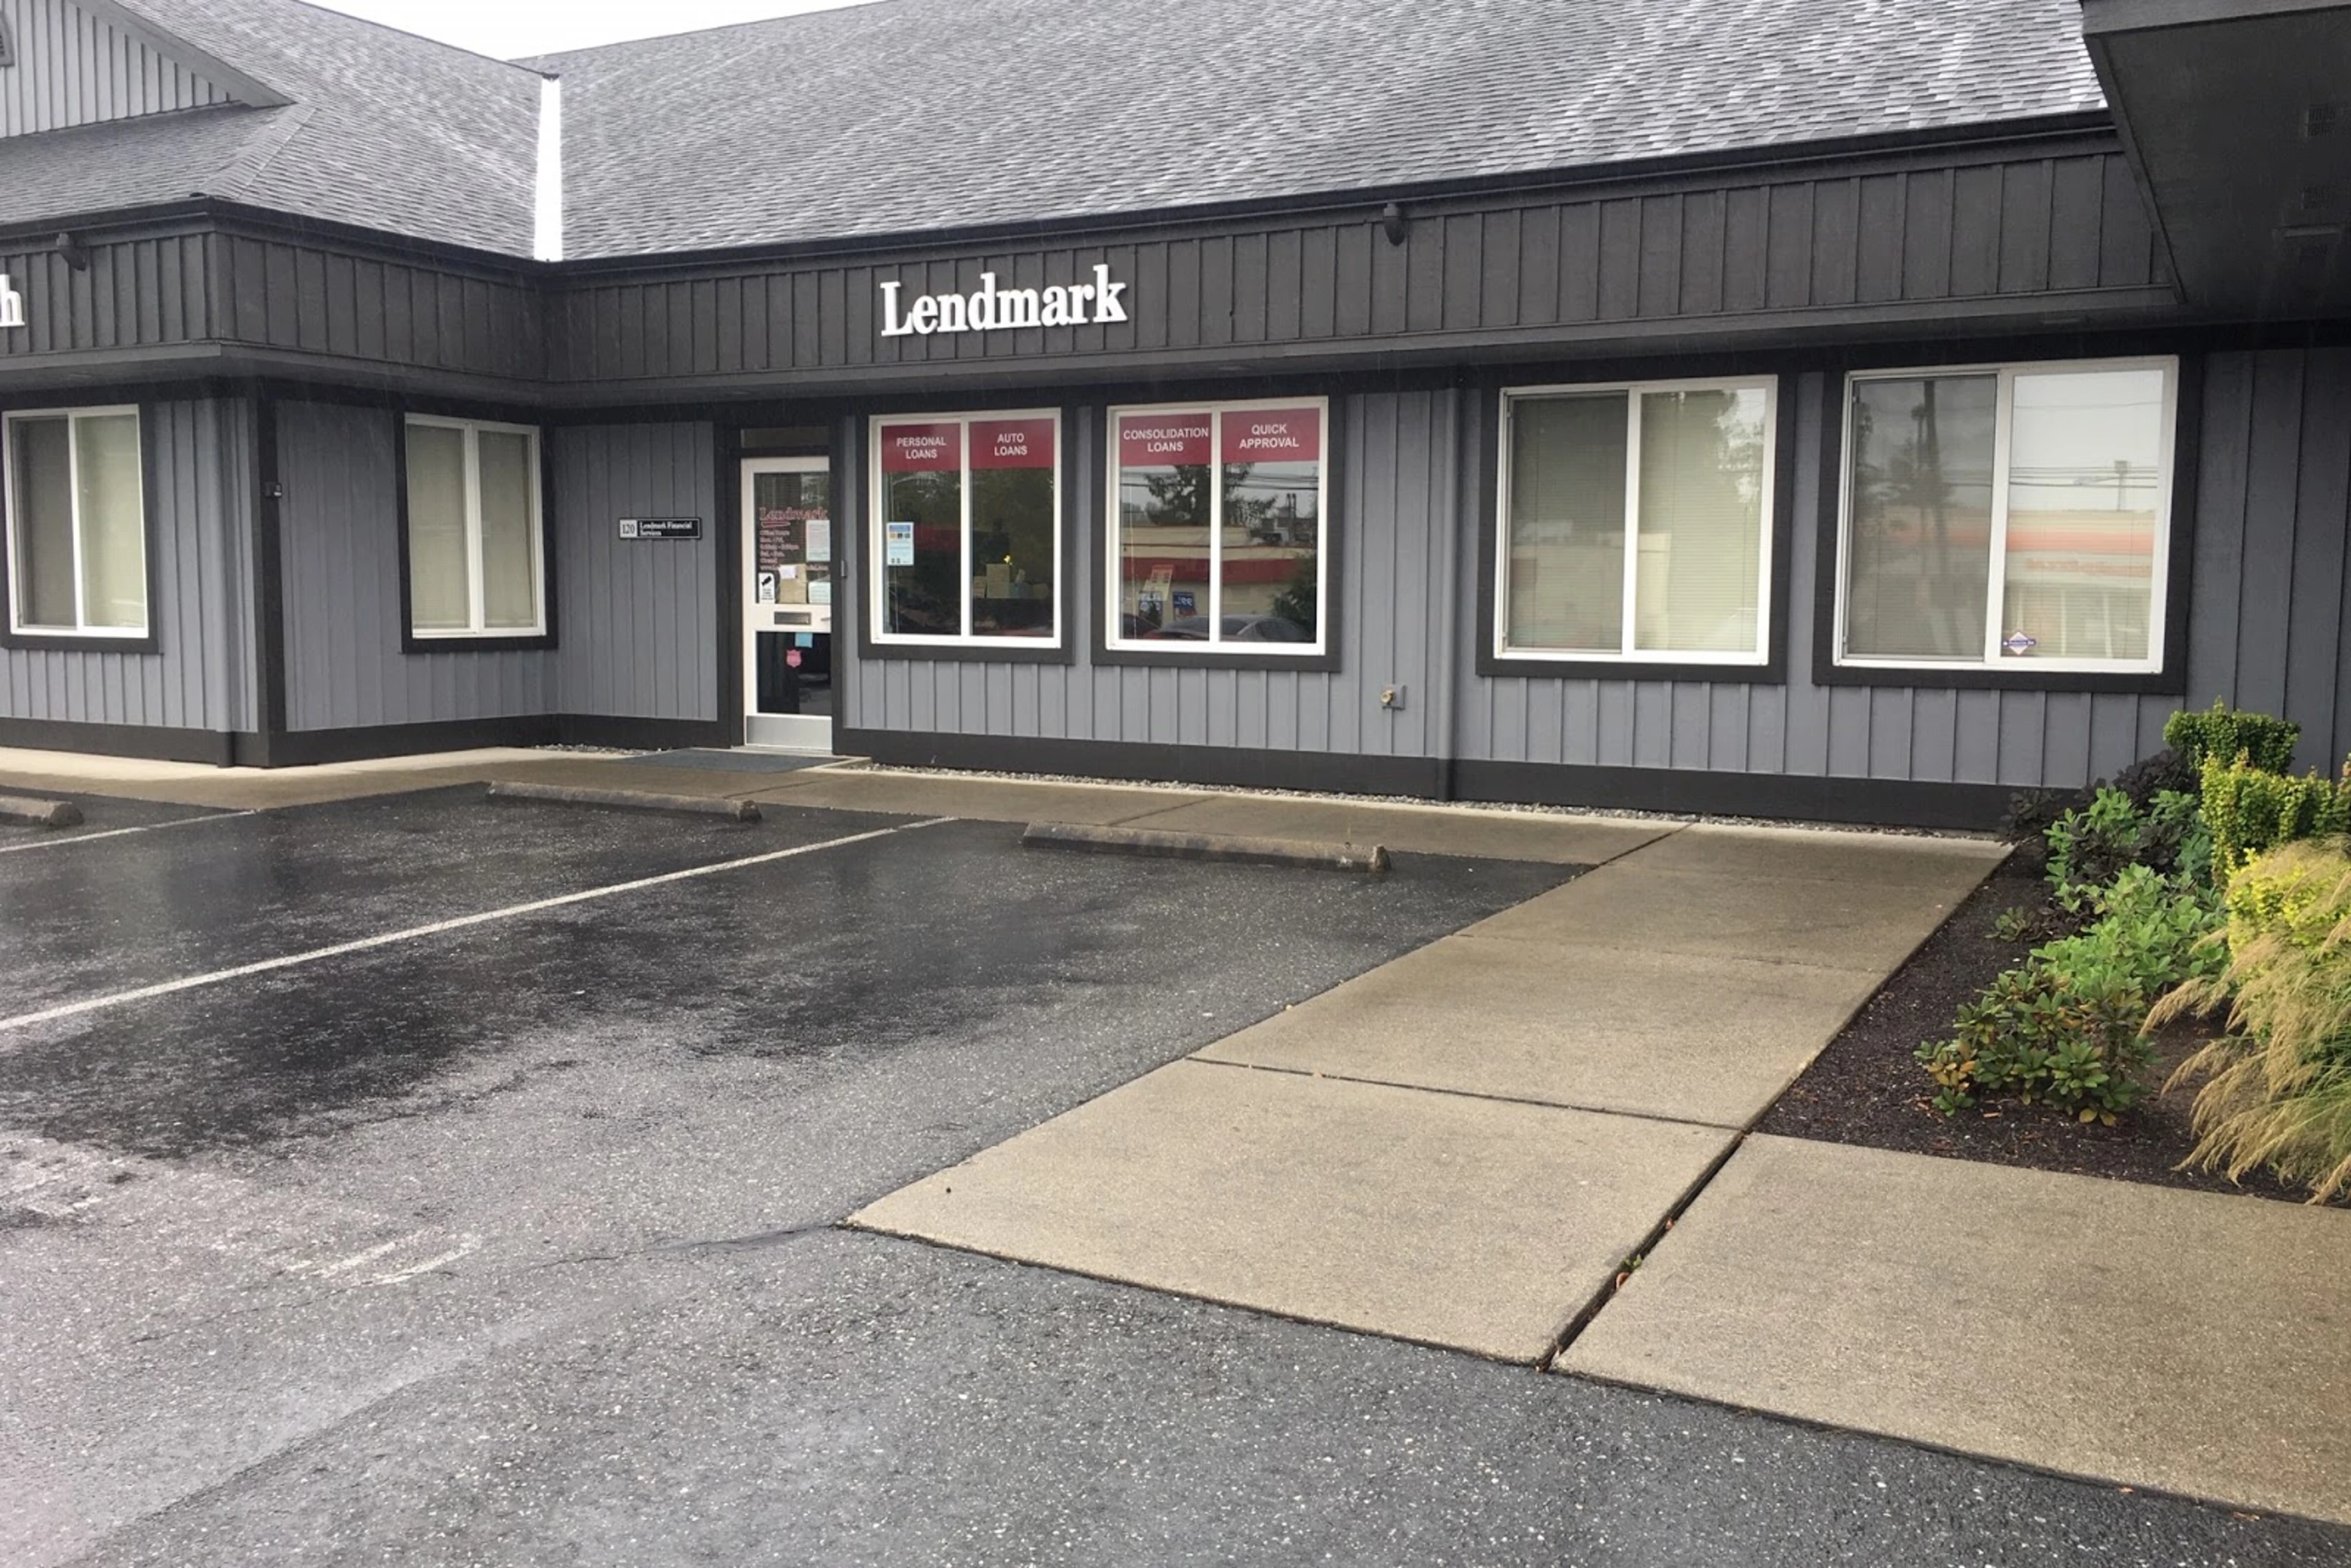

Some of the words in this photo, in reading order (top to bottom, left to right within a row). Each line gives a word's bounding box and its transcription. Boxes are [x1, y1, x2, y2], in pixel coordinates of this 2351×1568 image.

[880, 264, 1127, 336] Lendmark
[1123, 427, 1209, 440] CONSOLIDATION
[1251, 423, 1287, 435] QUICK
[896, 437, 947, 447] PERSONAL
[997, 433, 1024, 443] AUTO
[1239, 437, 1299, 449] APPROVAL
[994, 445, 1028, 456] LOANS
[1147, 441, 1184, 452] LOANS
[906, 449, 937, 459] LOANS
[759, 506, 828, 520] Lendmark
[667, 521, 692, 530] Financial
